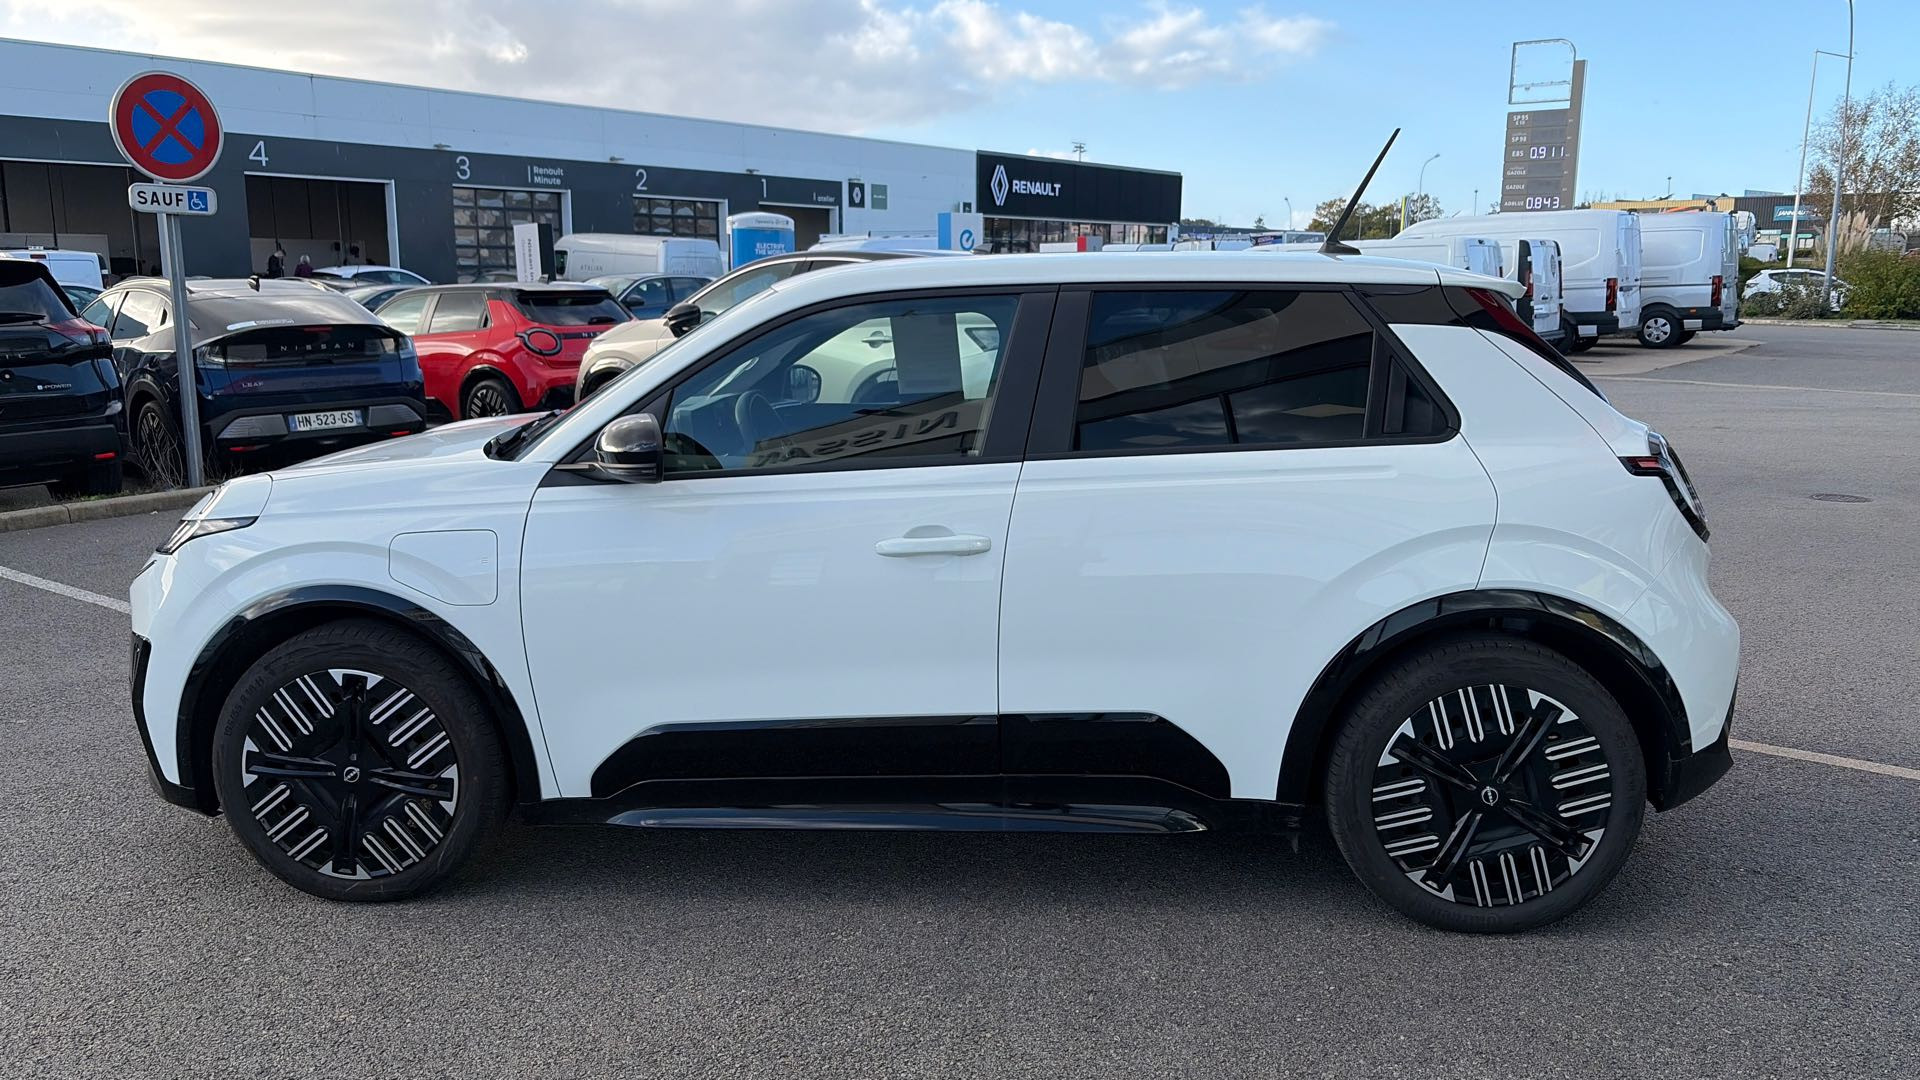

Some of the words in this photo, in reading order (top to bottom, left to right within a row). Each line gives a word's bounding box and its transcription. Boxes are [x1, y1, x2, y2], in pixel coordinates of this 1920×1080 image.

[248, 140, 269, 167] 4
[456, 155, 471, 180] 3
[533, 165, 564, 177] Renault
[534, 175, 561, 185] Minute
[635, 168, 648, 191] 2
[1012, 179, 1061, 197] RENAULT
[761, 178, 767, 199] 1
[136, 190, 184, 207] SAUF
[1525, 196, 1560, 210] 0.843
[280, 342, 355, 352] NISSAN
